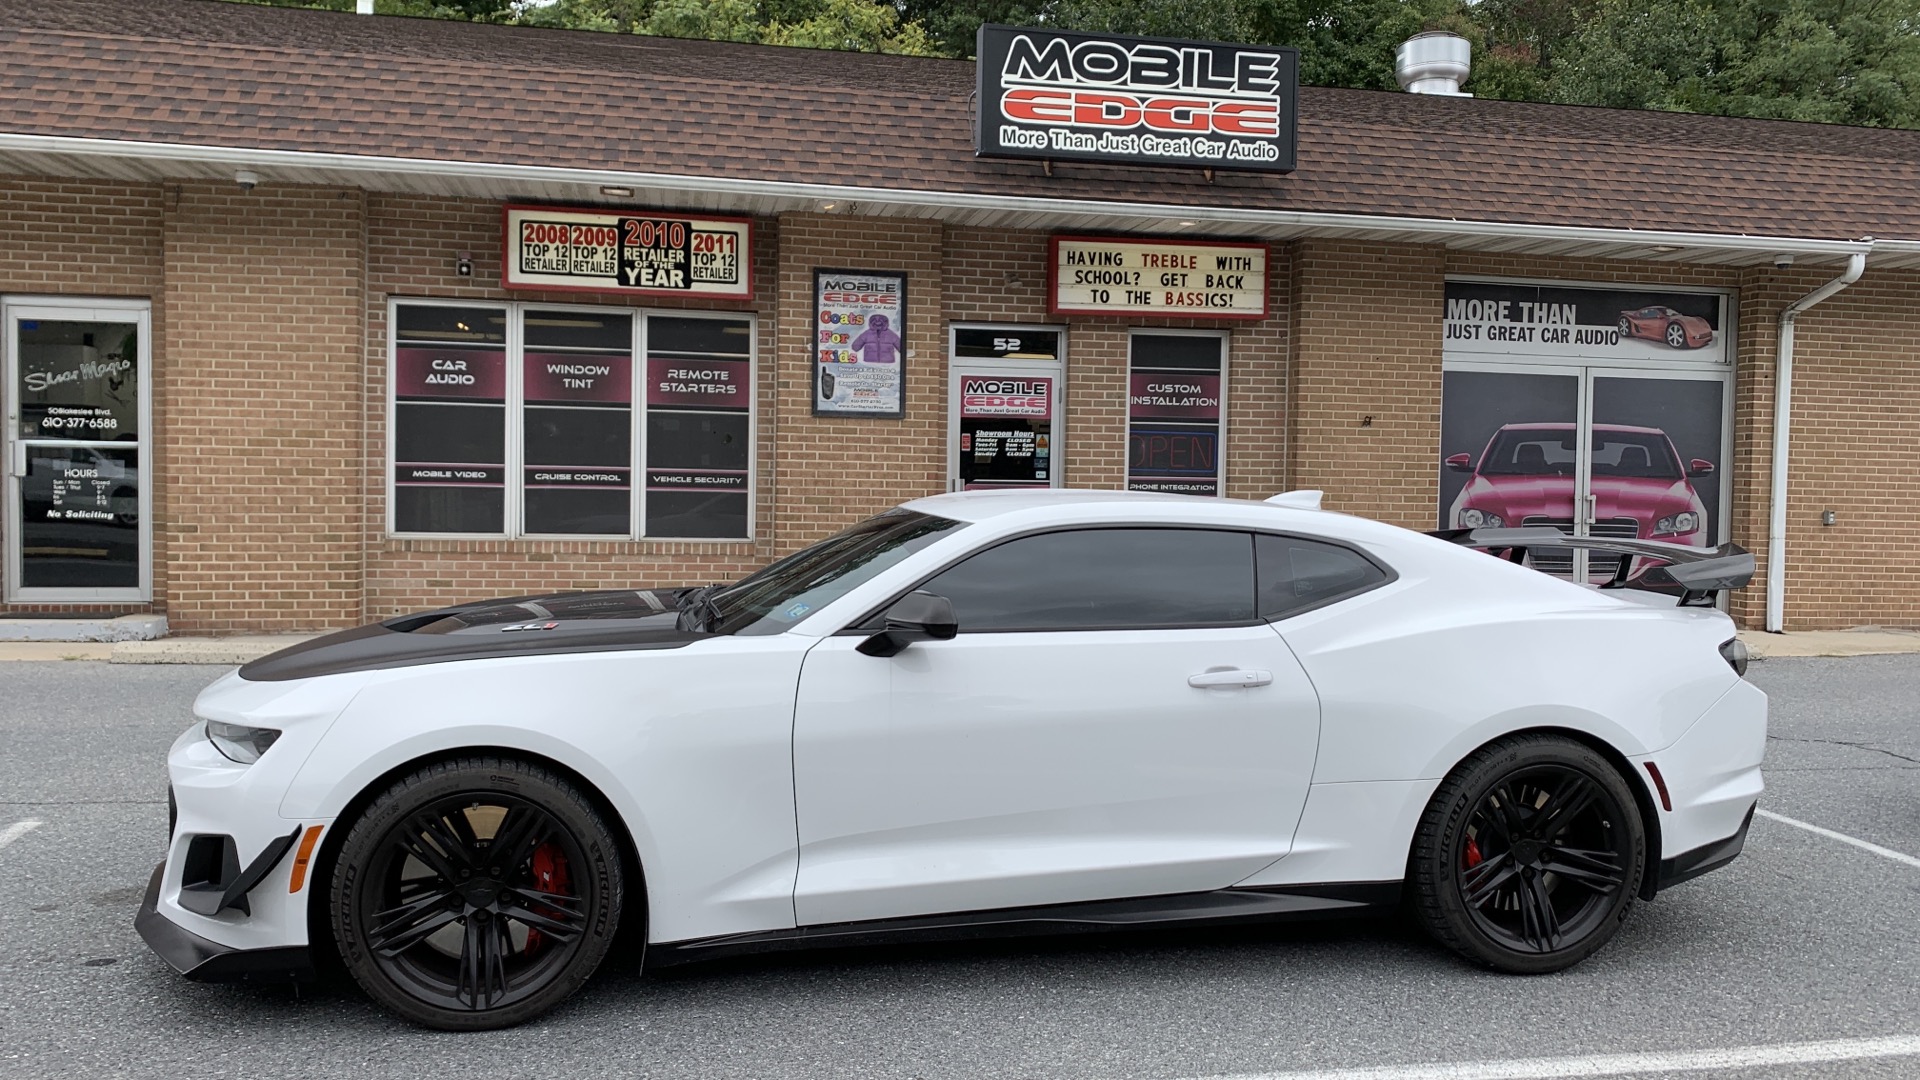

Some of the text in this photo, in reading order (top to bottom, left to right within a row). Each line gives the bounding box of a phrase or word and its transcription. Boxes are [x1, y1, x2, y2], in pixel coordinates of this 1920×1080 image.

[1002, 35, 1281, 94] MOBILE
[1001, 87, 1280, 137] EDGE
[1001, 126, 1278, 161] More Than Just Great Car Audio
[523, 223, 569, 243] 2008
[572, 226, 617, 247] 2009
[624, 220, 685, 249] 2010
[525, 244, 568, 258] TOP 12
[693, 234, 735, 254] 2011
[573, 246, 616, 261] TOP 12
[624, 247, 685, 263] RETAILER
[693, 253, 734, 267] TOP 12
[524, 258, 568, 272] RETAILER
[573, 260, 616, 274] RETAILER
[652, 261, 675, 269] THE
[1067, 251, 1251, 271] HAVING TREBLE WITH
[624, 267, 685, 288] YEAR
[693, 267, 734, 280] RETAILER
[1075, 270, 1244, 289] SCHOOL? GET BACK
[824, 281, 896, 293] MOBILE
[823, 292, 896, 304] EDGE
[1091, 289, 1233, 307] TO THE BASSICS!
[820, 310, 864, 325] Coats
[1448, 298, 1577, 325] MORE THAN
[820, 330, 850, 344] For
[1446, 323, 1619, 346] JUST GREAT CAR AUDIO
[993, 338, 1021, 351] 52
[820, 350, 858, 364] Kids
[431, 359, 467, 372] CAR
[547, 363, 610, 376] WINDOW
[425, 373, 475, 386] AUDIO
[667, 369, 729, 381] REMOTE
[563, 377, 593, 389] TINT
[659, 381, 737, 395] STARTERS
[964, 380, 1047, 395] MOBILE
[1147, 384, 1201, 394] CUSTOM
[964, 395, 1046, 408] EDGE
[1130, 396, 1218, 407] INSTALLATION
[42, 417, 117, 428] 610-377-6588
[1129, 434, 1212, 468] OPEN
[64, 468, 98, 477] HOURS
[412, 470, 487, 479] MOBILE VIDEO
[534, 473, 621, 482] CRUISE CONTROL
[653, 475, 742, 484] VEHICLE SECURITY
[47, 510, 114, 520] No Soliciting
[1441, 796, 1467, 864] MICHELIN
[597, 860, 611, 936] MICHELIN
[342, 868, 355, 943] MICHELIN
